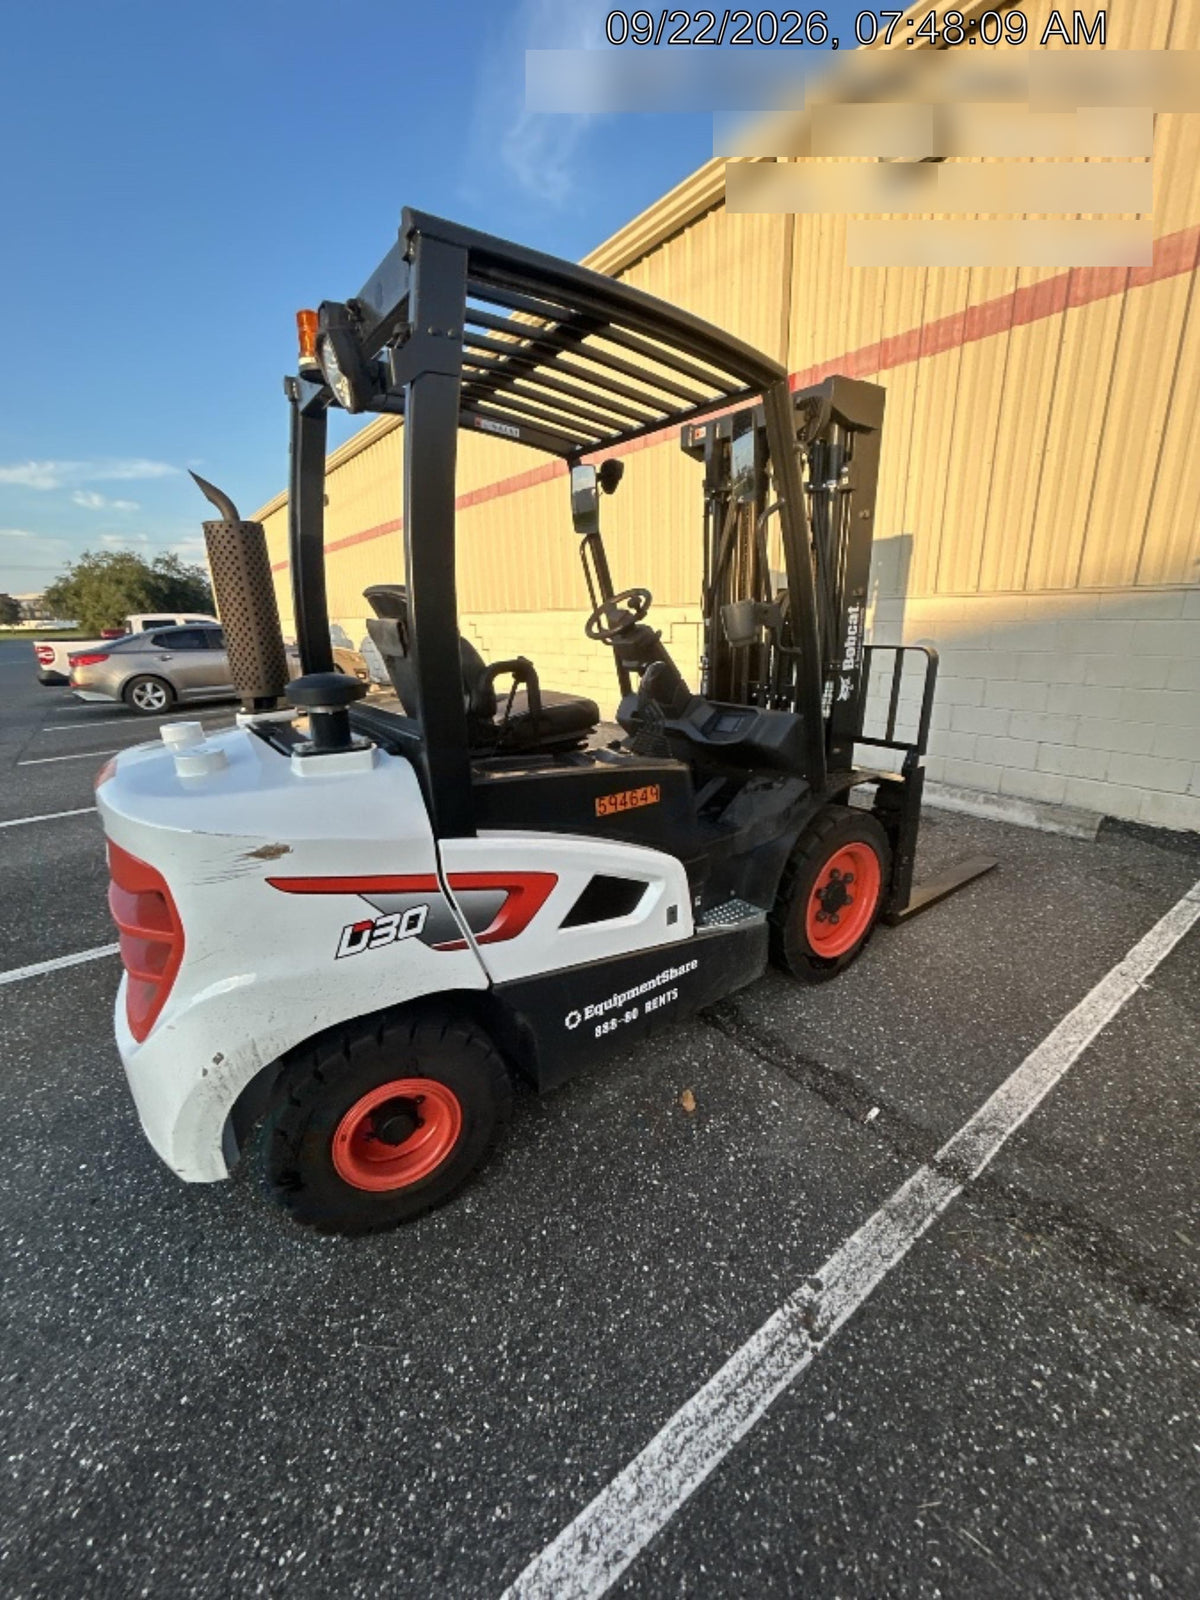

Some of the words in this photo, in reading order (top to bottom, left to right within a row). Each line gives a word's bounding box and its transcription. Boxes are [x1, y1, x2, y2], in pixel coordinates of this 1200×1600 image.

[842, 605, 859, 671] Bobcat
[598, 785, 659, 815] 594649
[334, 903, 430, 960] D30
[584, 958, 699, 1021] EquipmentShare
[645, 988, 679, 1014] RENTS
